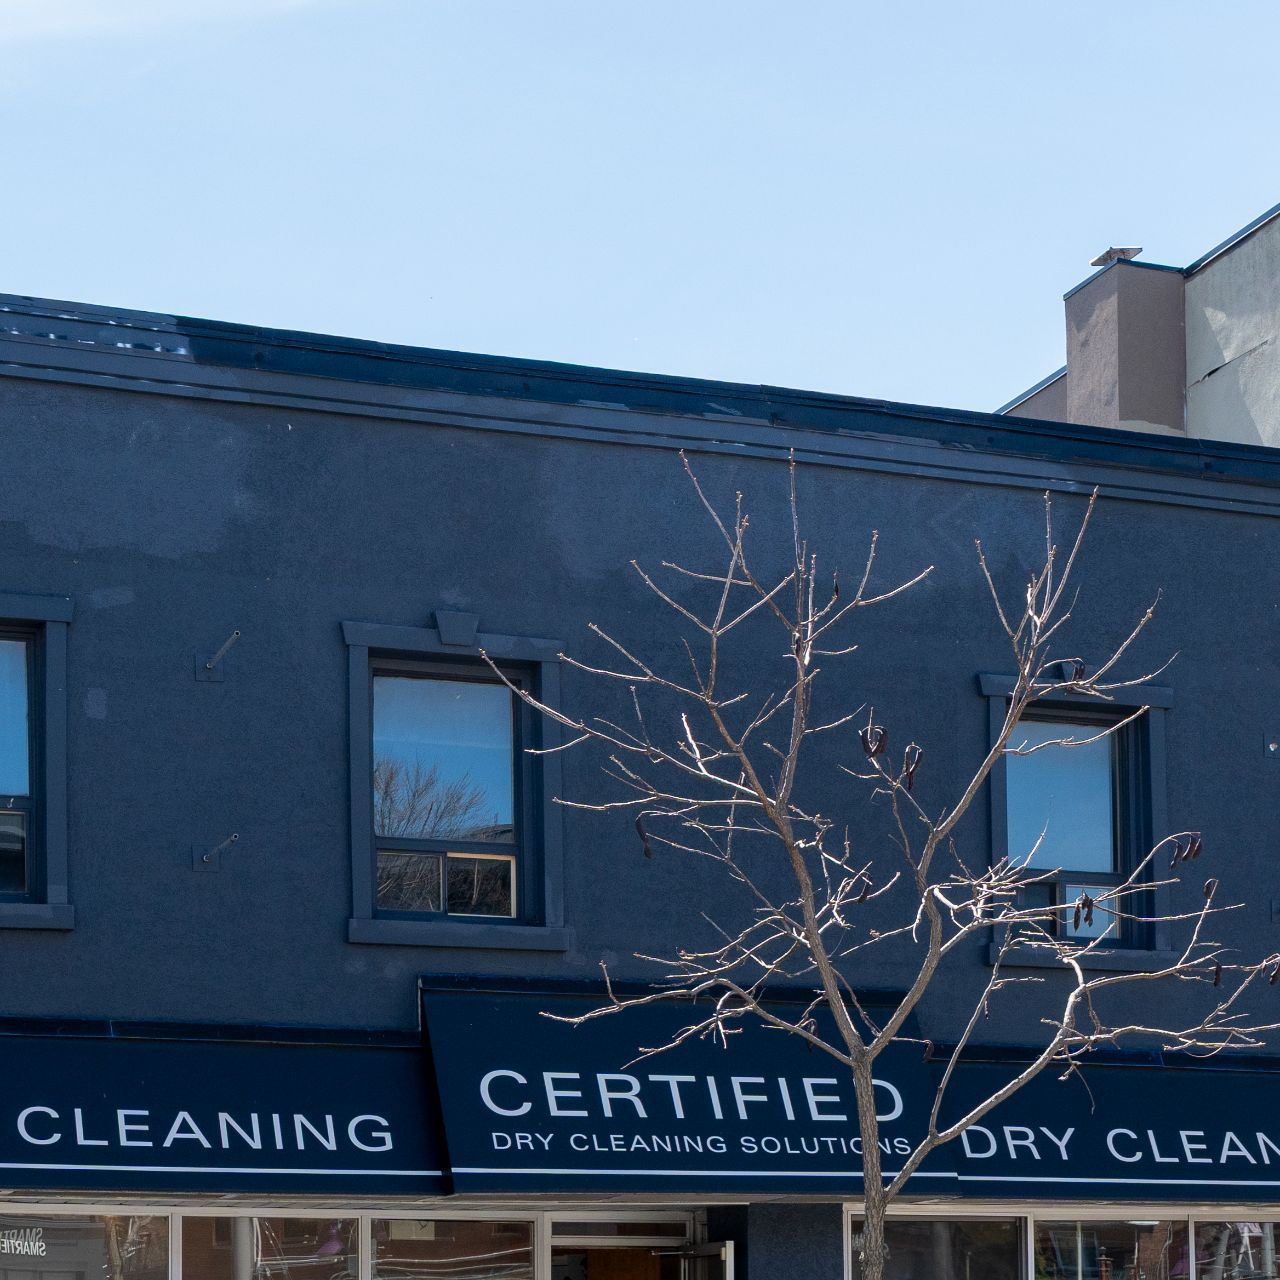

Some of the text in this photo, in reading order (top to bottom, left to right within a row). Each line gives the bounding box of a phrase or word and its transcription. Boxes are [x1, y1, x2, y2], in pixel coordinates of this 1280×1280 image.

[479, 1069, 904, 1121] CERTIFIED
[16, 1106, 394, 1152] CLEANING
[491, 1132, 554, 1151] DRY
[569, 1134, 727, 1153] CLEANING
[960, 1125, 1075, 1160] DRY
